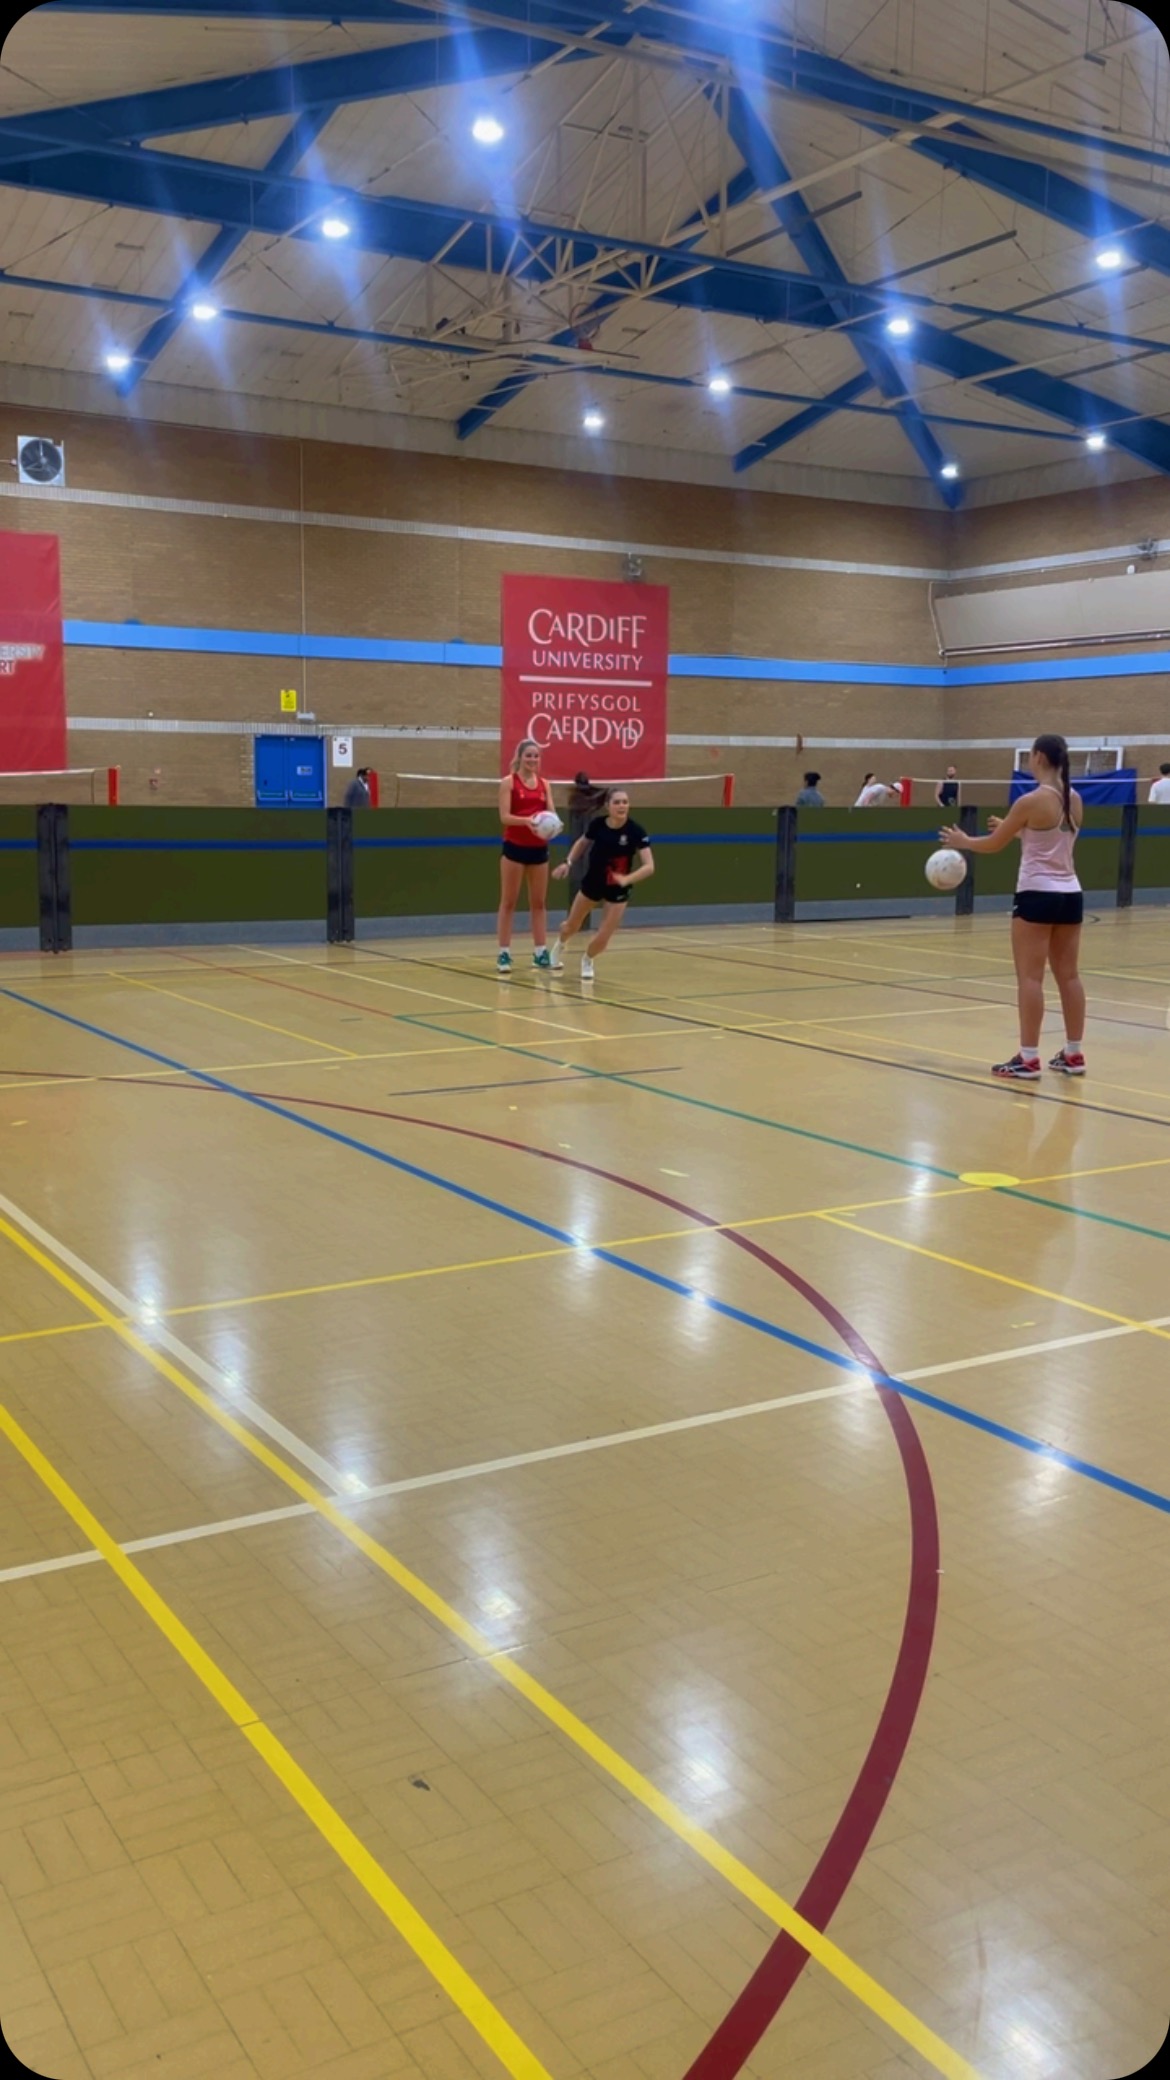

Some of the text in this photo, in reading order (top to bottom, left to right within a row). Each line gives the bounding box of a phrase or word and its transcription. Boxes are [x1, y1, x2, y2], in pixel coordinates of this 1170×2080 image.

[528, 608, 648, 649] CARDIFF
[532, 649, 643, 671] UNIVERSITY
[532, 692, 642, 712] PRIFYSGOL
[527, 713, 645, 750] CAERDYDD
[338, 743, 348, 755] 5
